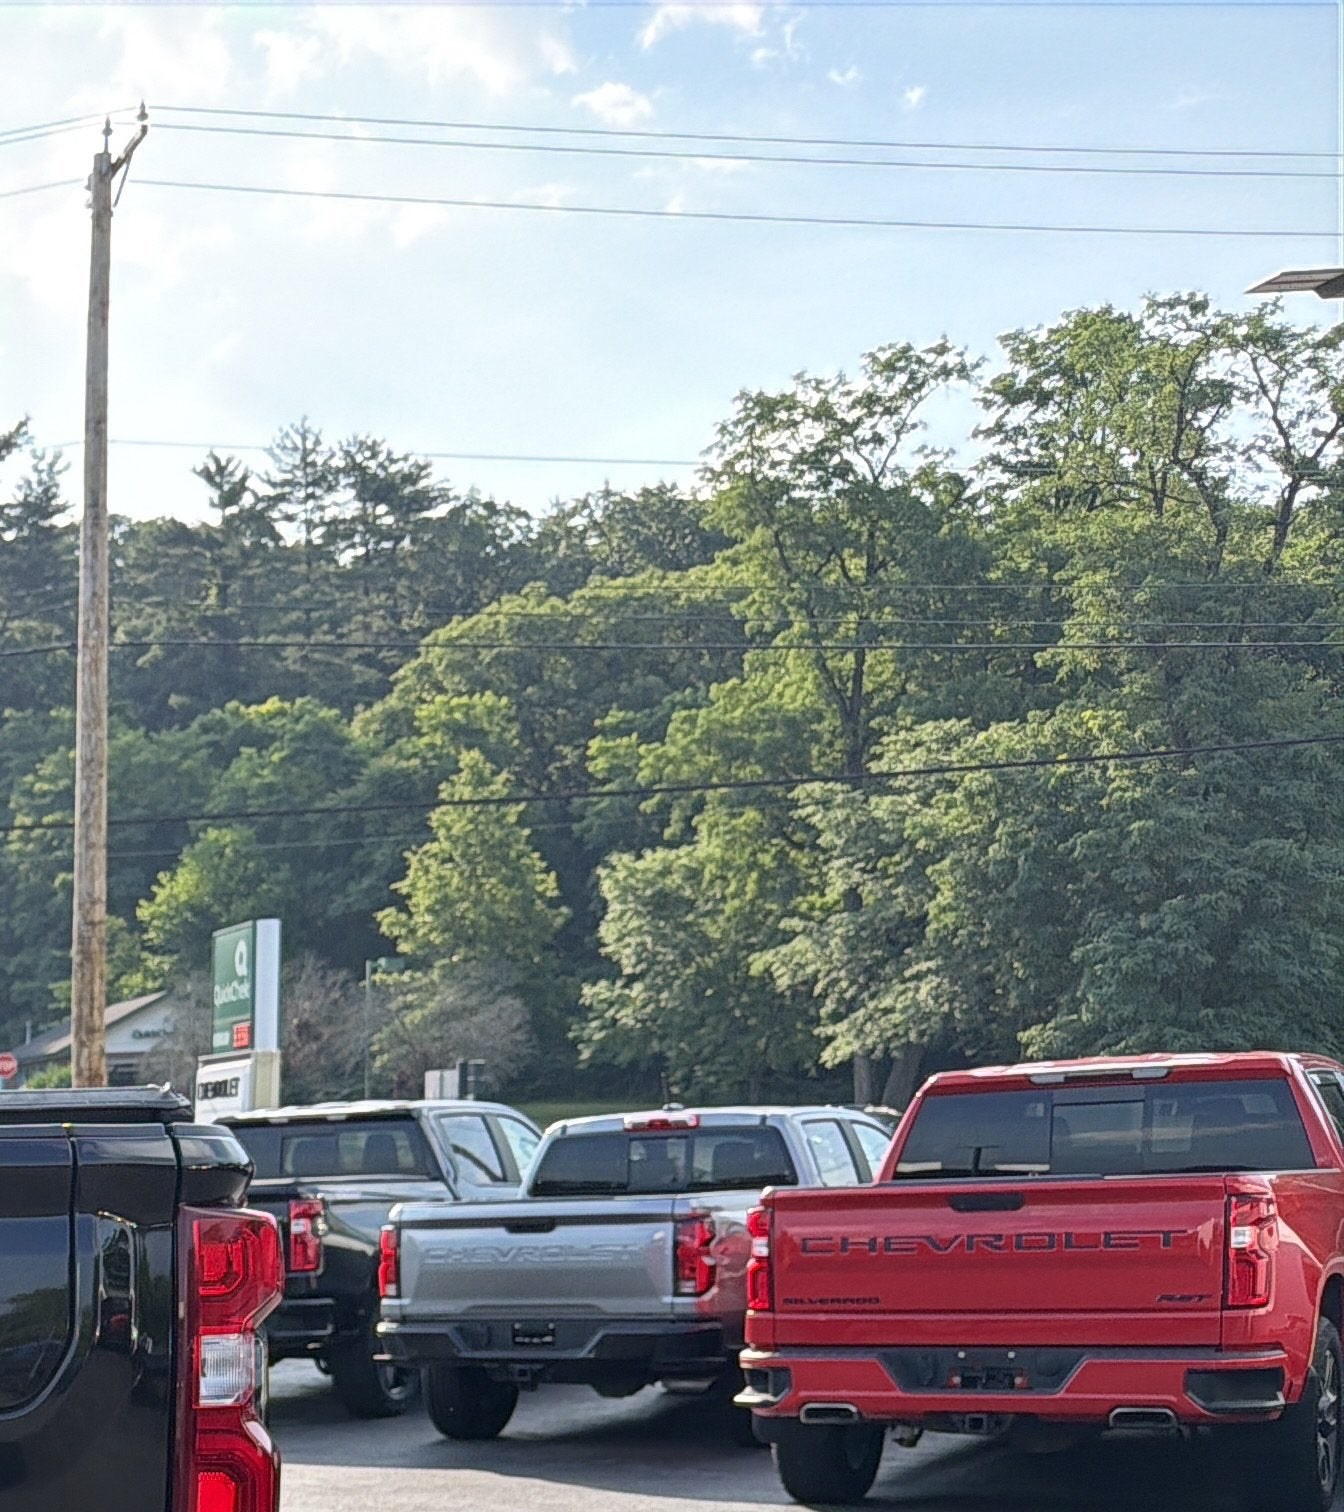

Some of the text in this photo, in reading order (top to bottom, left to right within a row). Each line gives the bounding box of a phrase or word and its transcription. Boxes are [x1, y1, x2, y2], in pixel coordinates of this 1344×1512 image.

[800, 1230, 1189, 1256] CHEVROLET
[423, 1245, 640, 1264] CHEVROLET
[783, 1297, 880, 1305] SILVERADO
